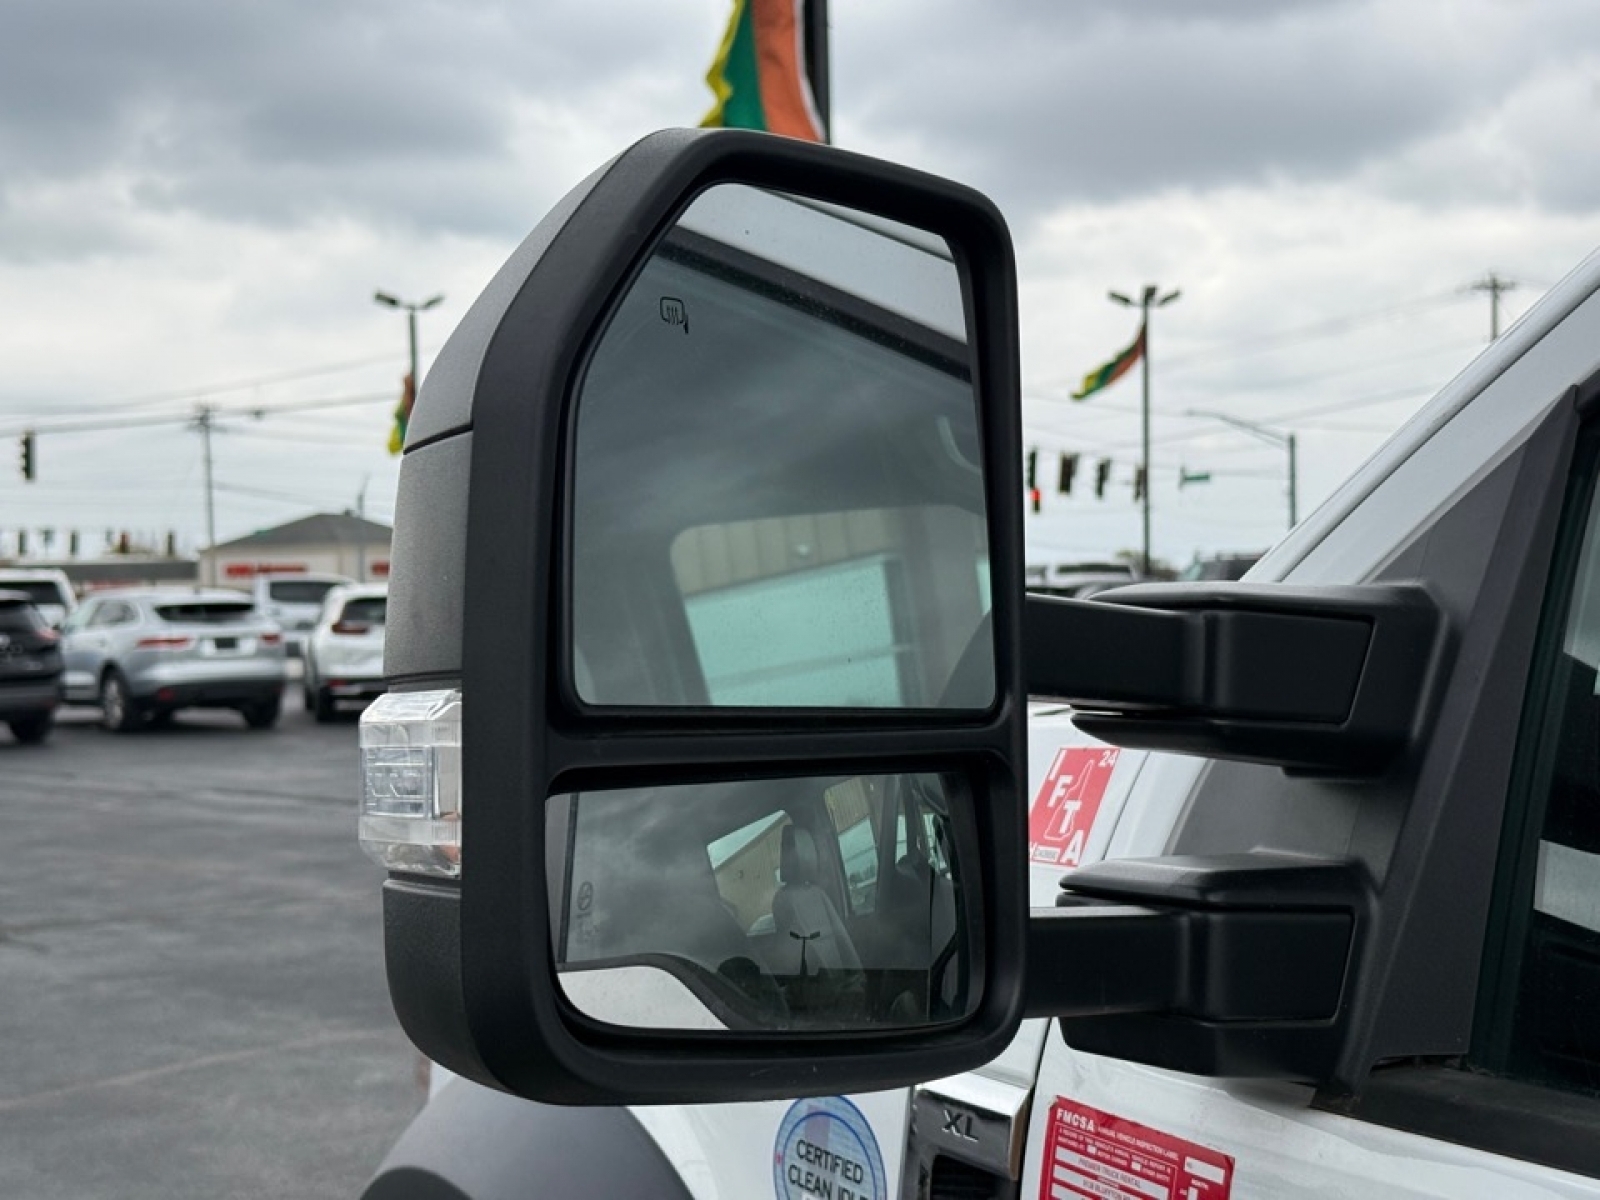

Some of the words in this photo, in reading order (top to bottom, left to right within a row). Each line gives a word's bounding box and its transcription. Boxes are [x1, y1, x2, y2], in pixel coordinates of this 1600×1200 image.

[1098, 750, 1118, 767] 24
[942, 1109, 979, 1142] XL
[1056, 1108, 1094, 1132] FMCSA
[796, 1139, 865, 1185] CERTIFIED
[788, 1164, 833, 1200] CLEAN
